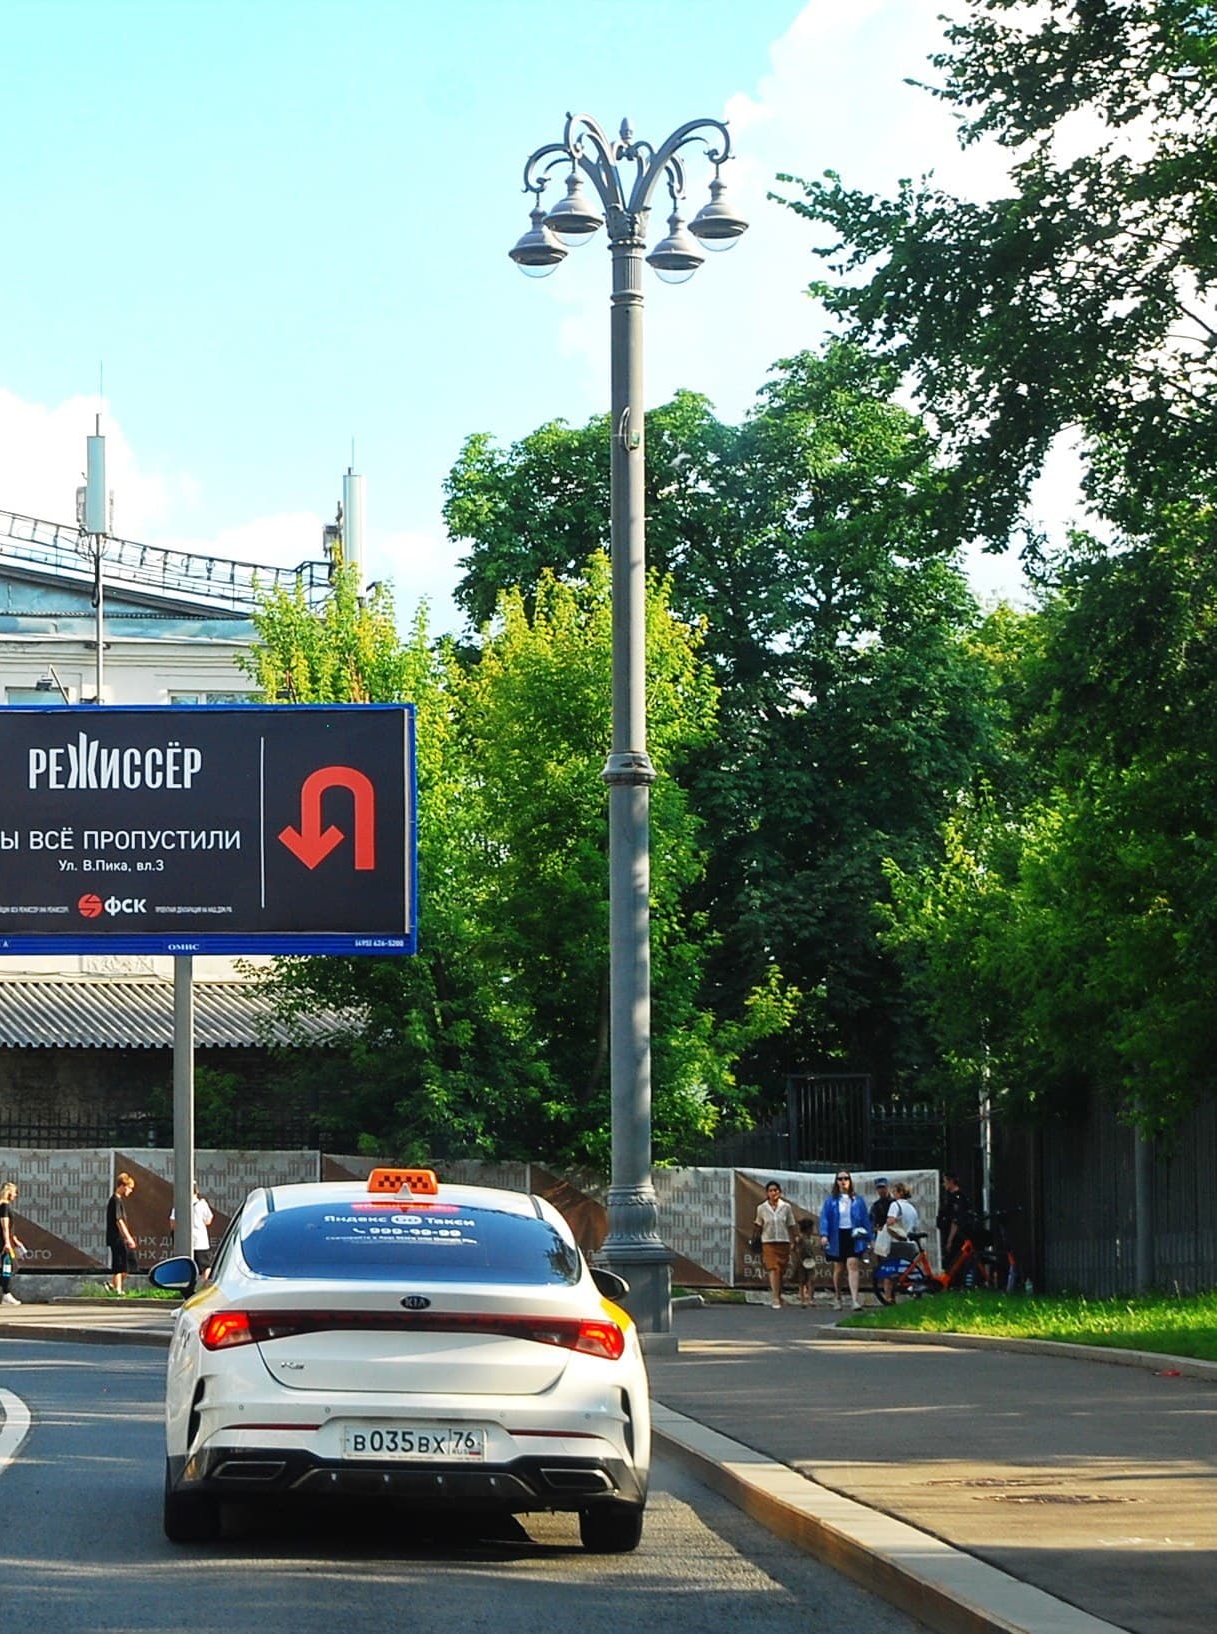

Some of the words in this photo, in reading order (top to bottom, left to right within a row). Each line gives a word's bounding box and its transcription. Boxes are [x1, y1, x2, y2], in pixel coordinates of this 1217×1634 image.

[29, 731, 202, 789] РЕЖИССЁР
[29, 827, 74, 849] ВСЁ
[84, 830, 241, 849] ПРОПУСТИЛИ
[58, 860, 78, 872] Ул.
[137, 859, 165, 871] вл.3
[324, 1215, 387, 1224] Яндекс
[425, 1217, 475, 1226] Такси
[405, 1297, 426, 1307] KIA
[452, 1431, 476, 1449] 76
